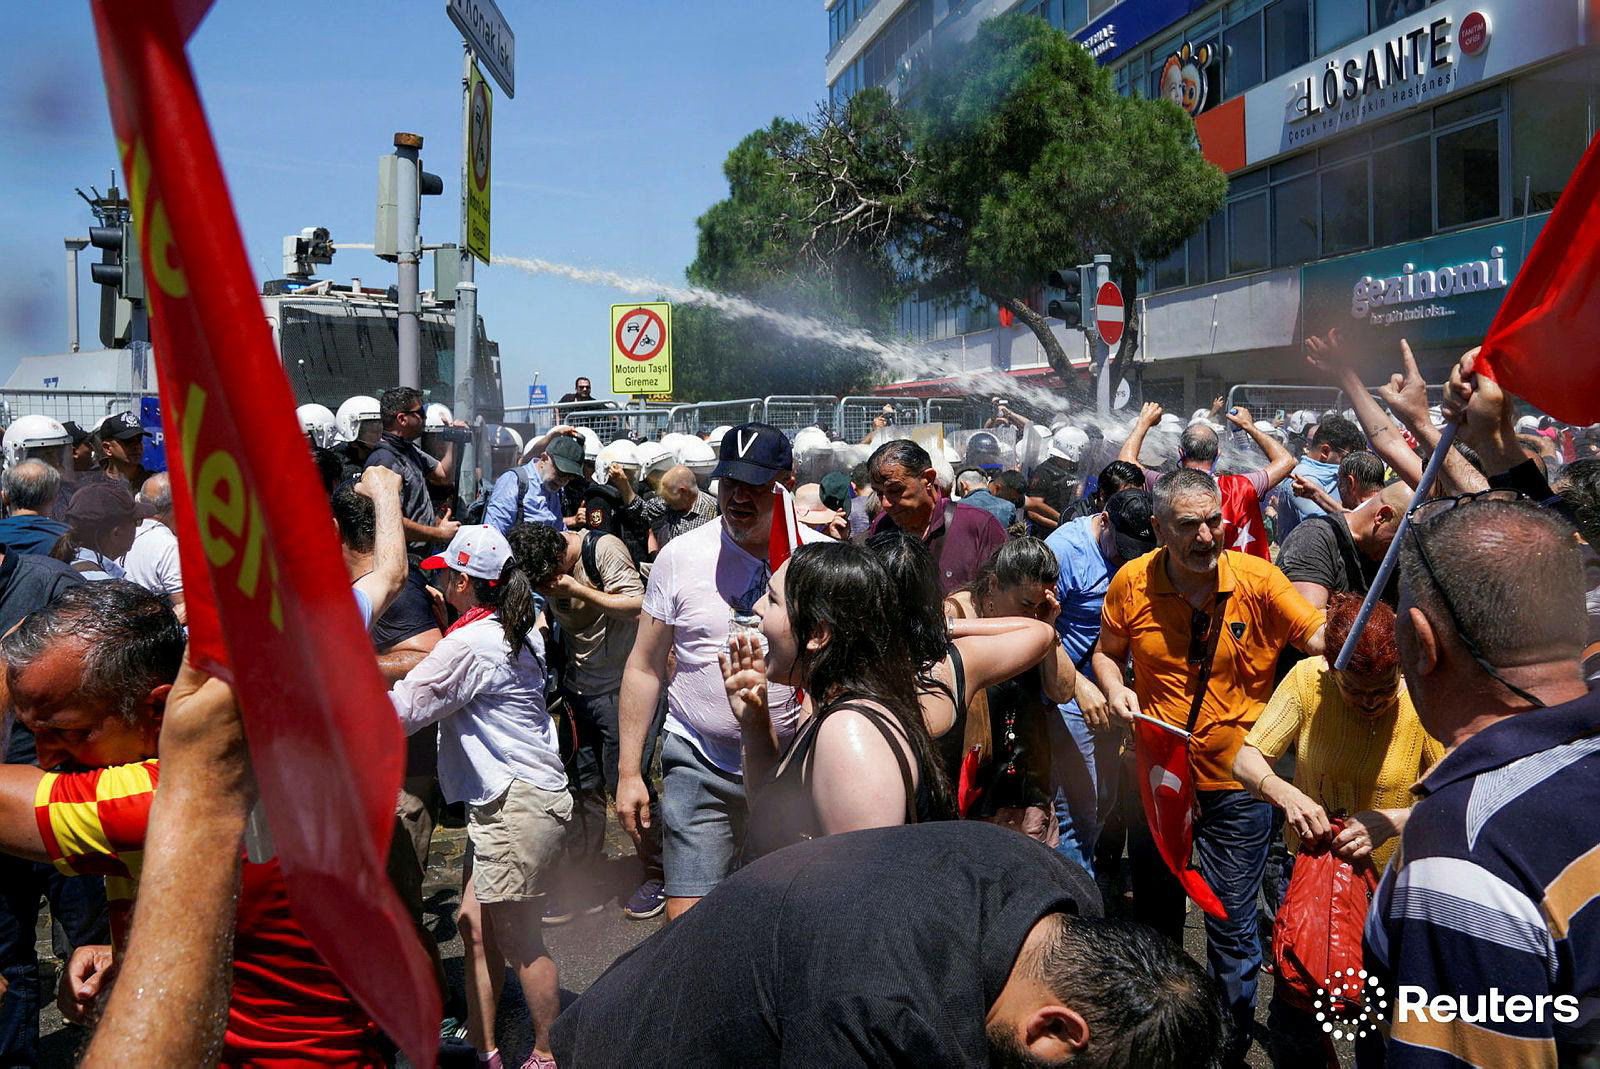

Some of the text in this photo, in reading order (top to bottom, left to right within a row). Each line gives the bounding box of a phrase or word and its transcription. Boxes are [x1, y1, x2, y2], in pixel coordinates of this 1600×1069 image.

[1301, 17, 1451, 116] LÖSANTE
[1288, 68, 1458, 145] Çocuk ve Yetişkin Hastanesi
[1351, 245, 1507, 319] gezinomi
[615, 363, 668, 374] Motorlu Taşıt
[624, 376, 659, 387] Giremez
[737, 429, 759, 458] V
